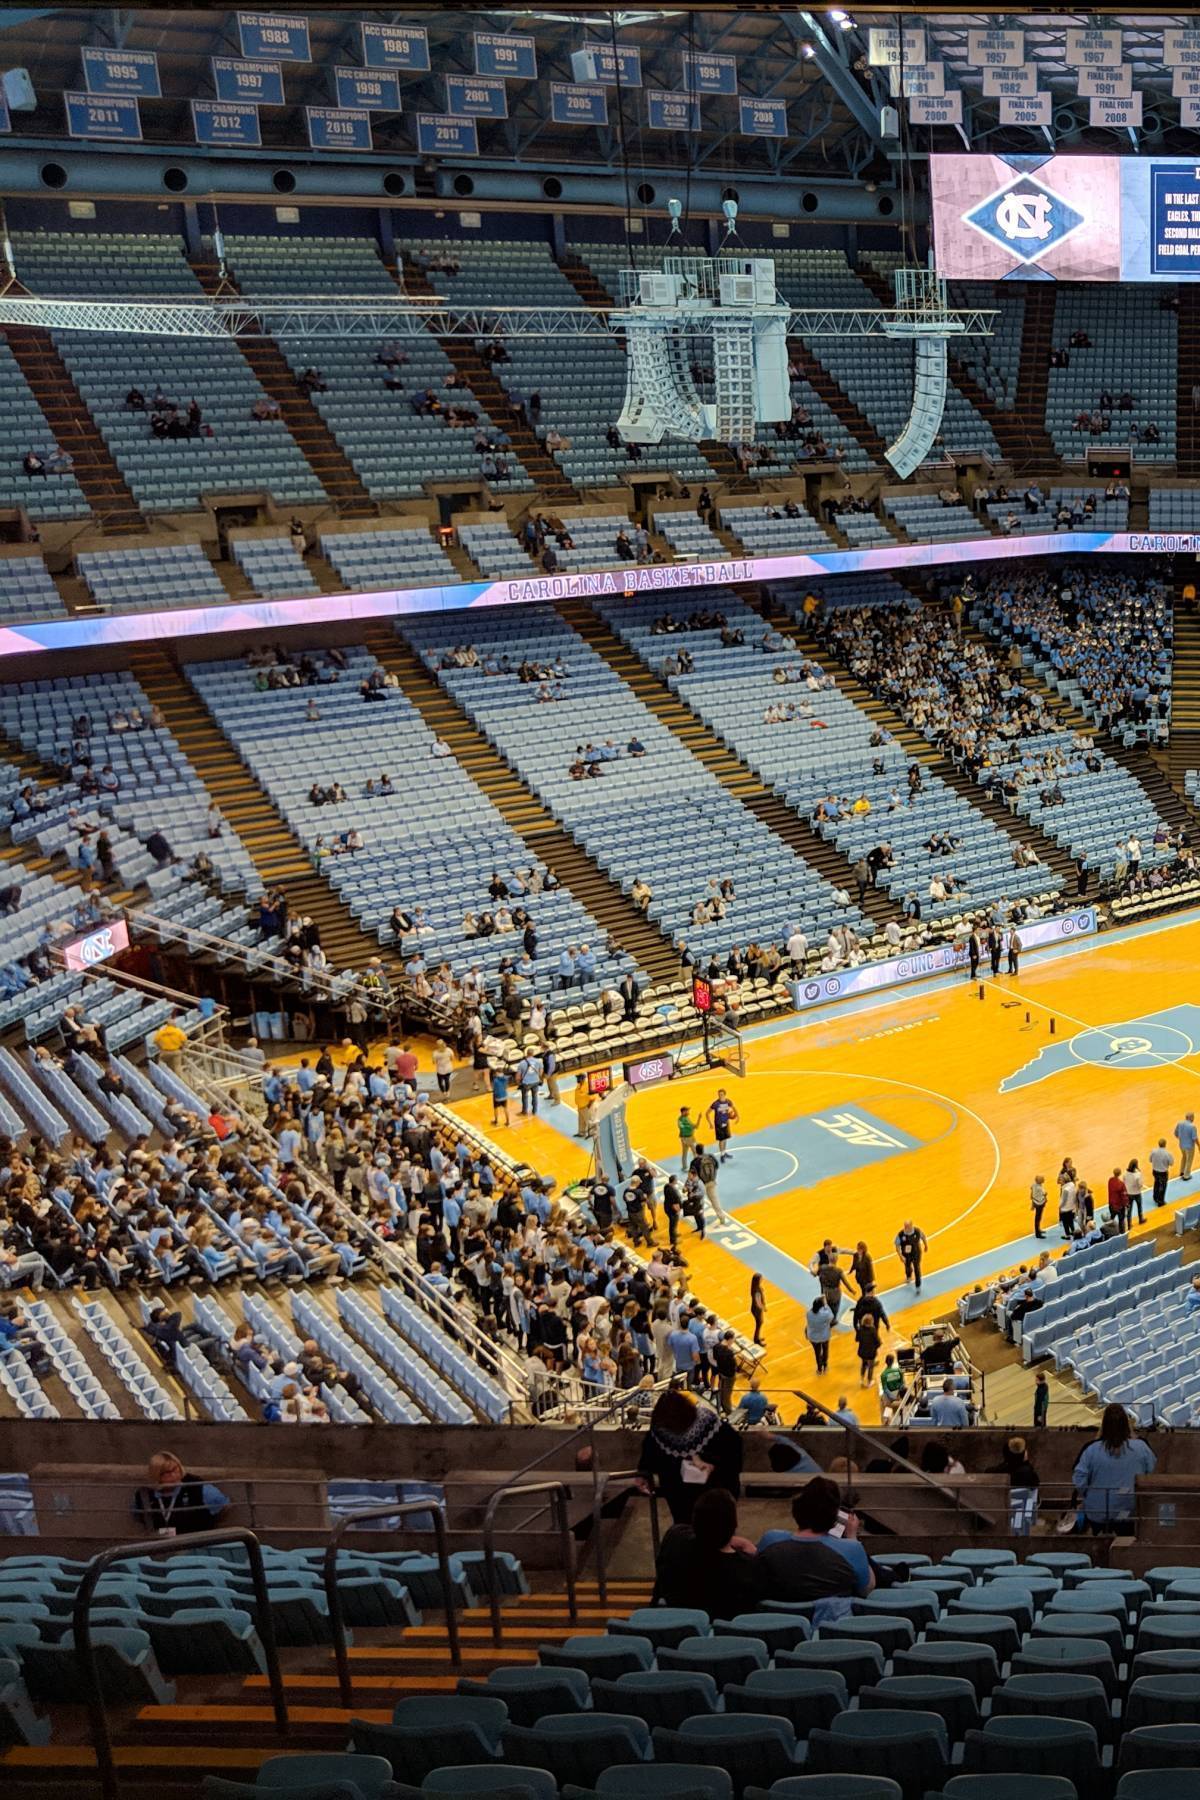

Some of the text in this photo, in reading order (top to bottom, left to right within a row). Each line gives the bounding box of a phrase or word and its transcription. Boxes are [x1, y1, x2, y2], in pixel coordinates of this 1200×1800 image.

[260, 30, 289, 44] 1988
[383, 40, 409, 53] 1989
[494, 49, 518, 62] 1991
[985, 52, 1007, 63] 1957
[1083, 52, 1105, 63] 1967
[106, 64, 139, 79] 1995
[236, 74, 262, 88] 1997
[355, 82, 382, 95] 1998
[908, 83, 928, 94] 1981
[999, 83, 1021, 94] 1982
[1095, 84, 1115, 95] 1991
[88, 109, 119, 123] 2011
[925, 111, 947, 121] 2000
[1014, 112, 1037, 121] 2005
[1105, 113, 1127, 123] 2008
[212, 116, 241, 129] 2012
[1173, 193, 1184, 205] THE
[1185, 193, 1199, 205] LAST
[1164, 228, 1187, 239] SECOND
[1158, 244, 1174, 255] FIELD
[1175, 244, 1189, 255] GOAL
[508, 562, 753, 601] CAROLINA BASKETBALL
